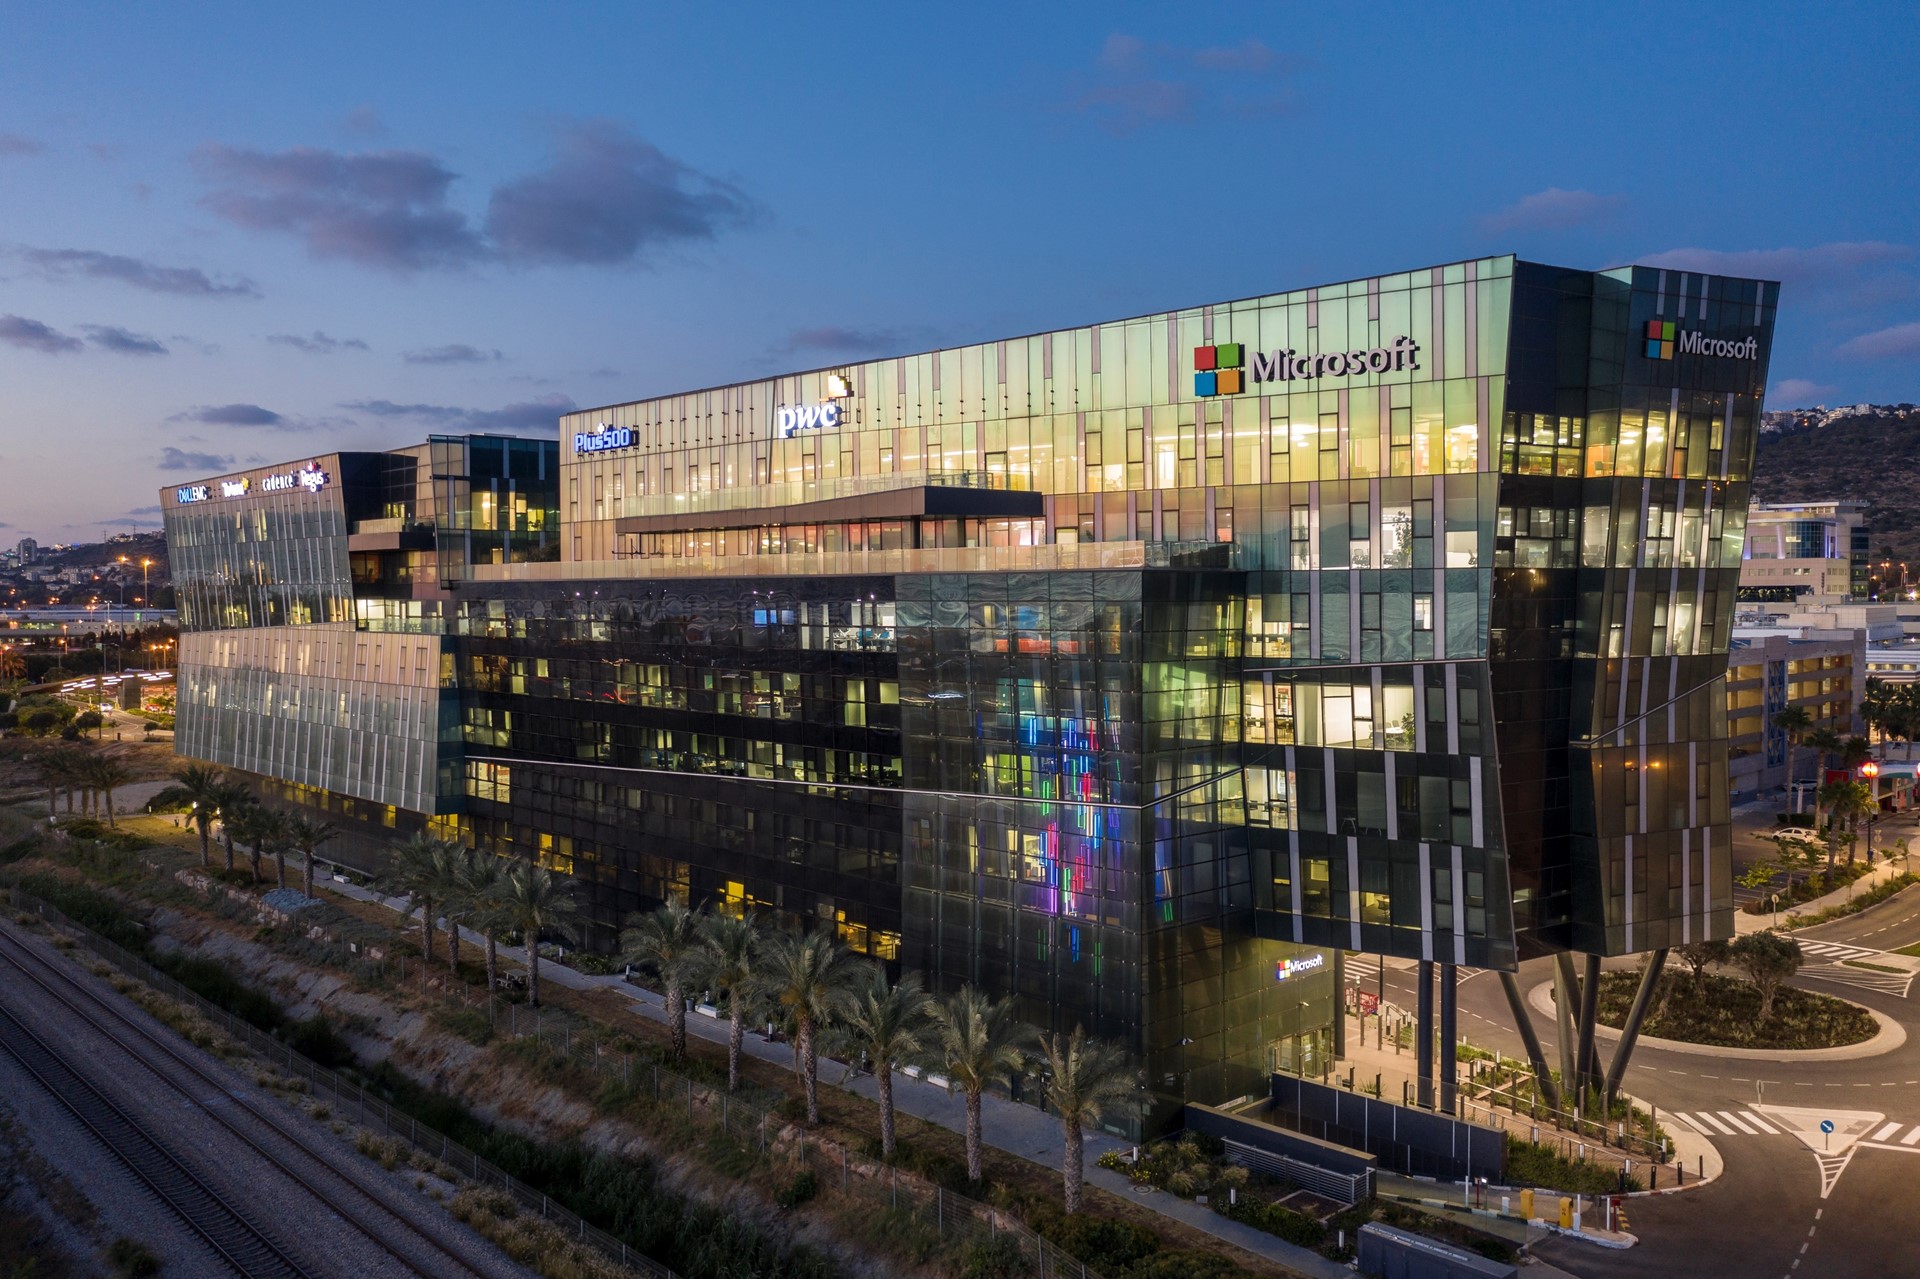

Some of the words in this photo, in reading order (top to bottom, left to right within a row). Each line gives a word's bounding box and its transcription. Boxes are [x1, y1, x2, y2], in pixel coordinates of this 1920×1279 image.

[1680, 330, 1757, 360] Microsoft
[1250, 335, 1416, 382] Microsoft
[778, 404, 836, 438] pwc
[575, 429, 630, 452] Plus500
[263, 474, 294, 491] cadence
[1290, 954, 1323, 973] Microsoft
